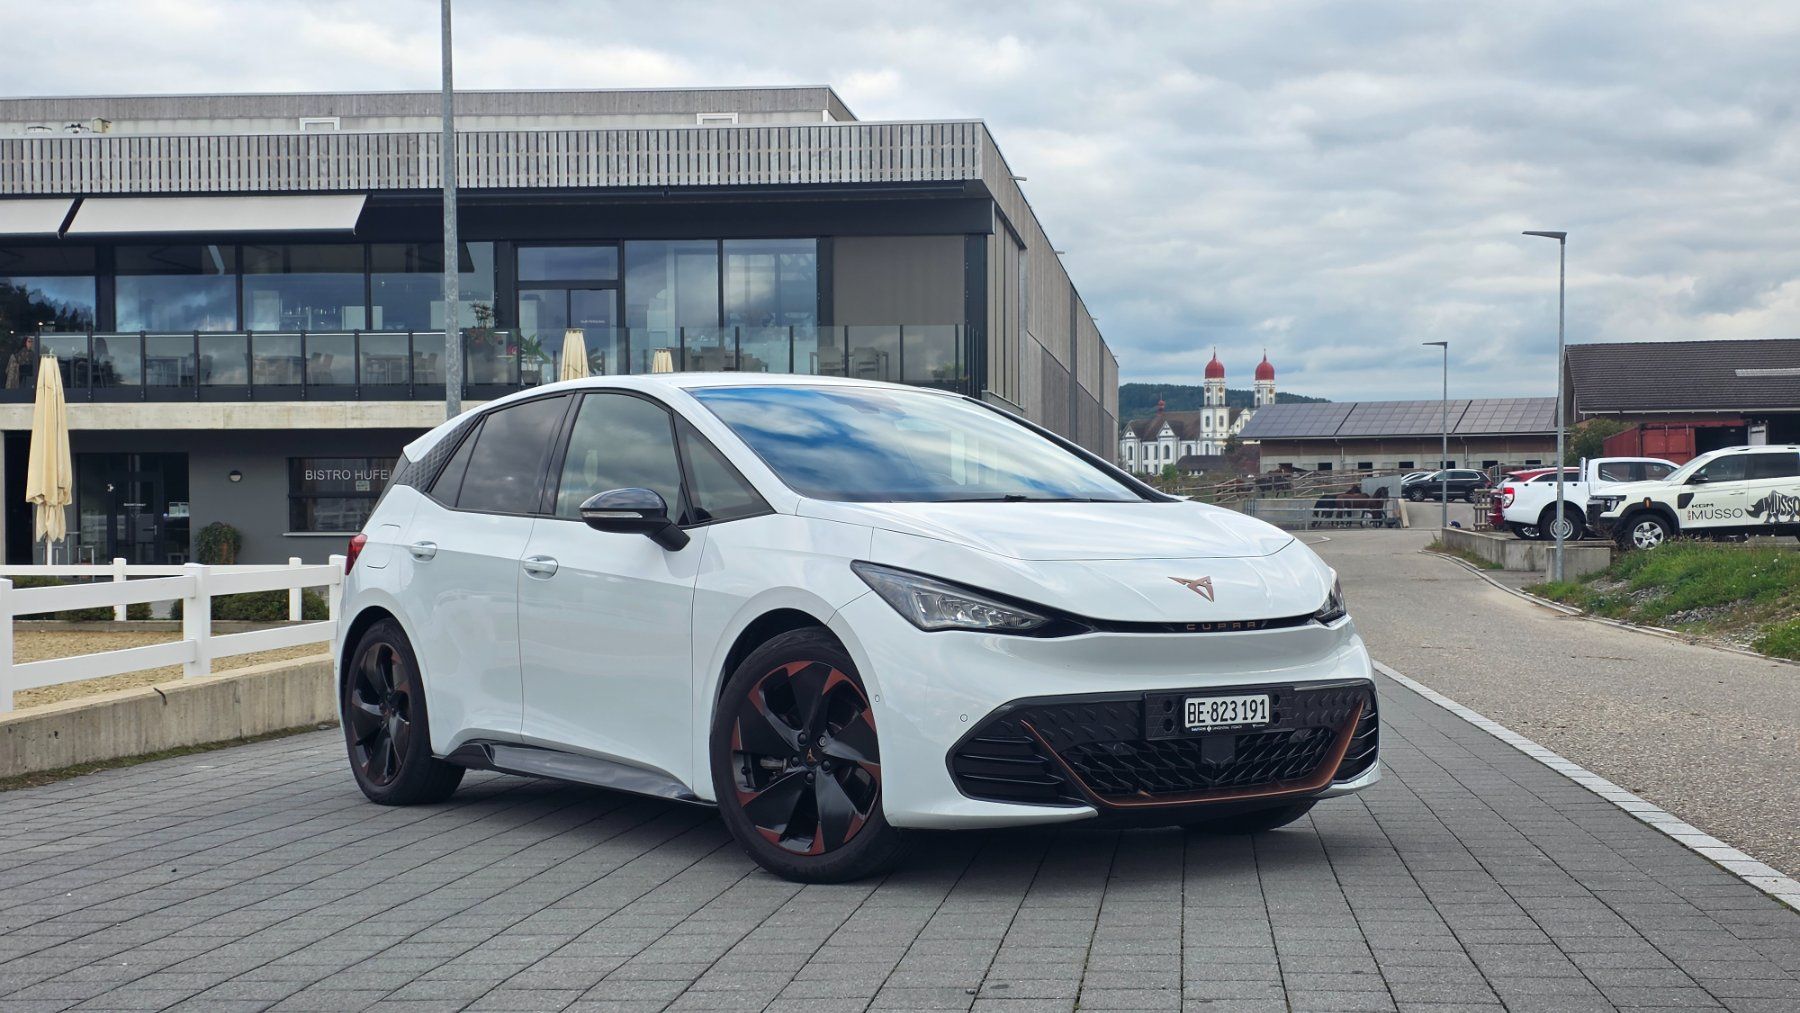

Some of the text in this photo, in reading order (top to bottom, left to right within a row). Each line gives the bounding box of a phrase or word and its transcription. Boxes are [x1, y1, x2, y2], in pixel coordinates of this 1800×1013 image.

[305, 469, 351, 480] BISTRO
[1691, 508, 1743, 520] MUSSO
[1186, 621, 1256, 631] CUPRA
